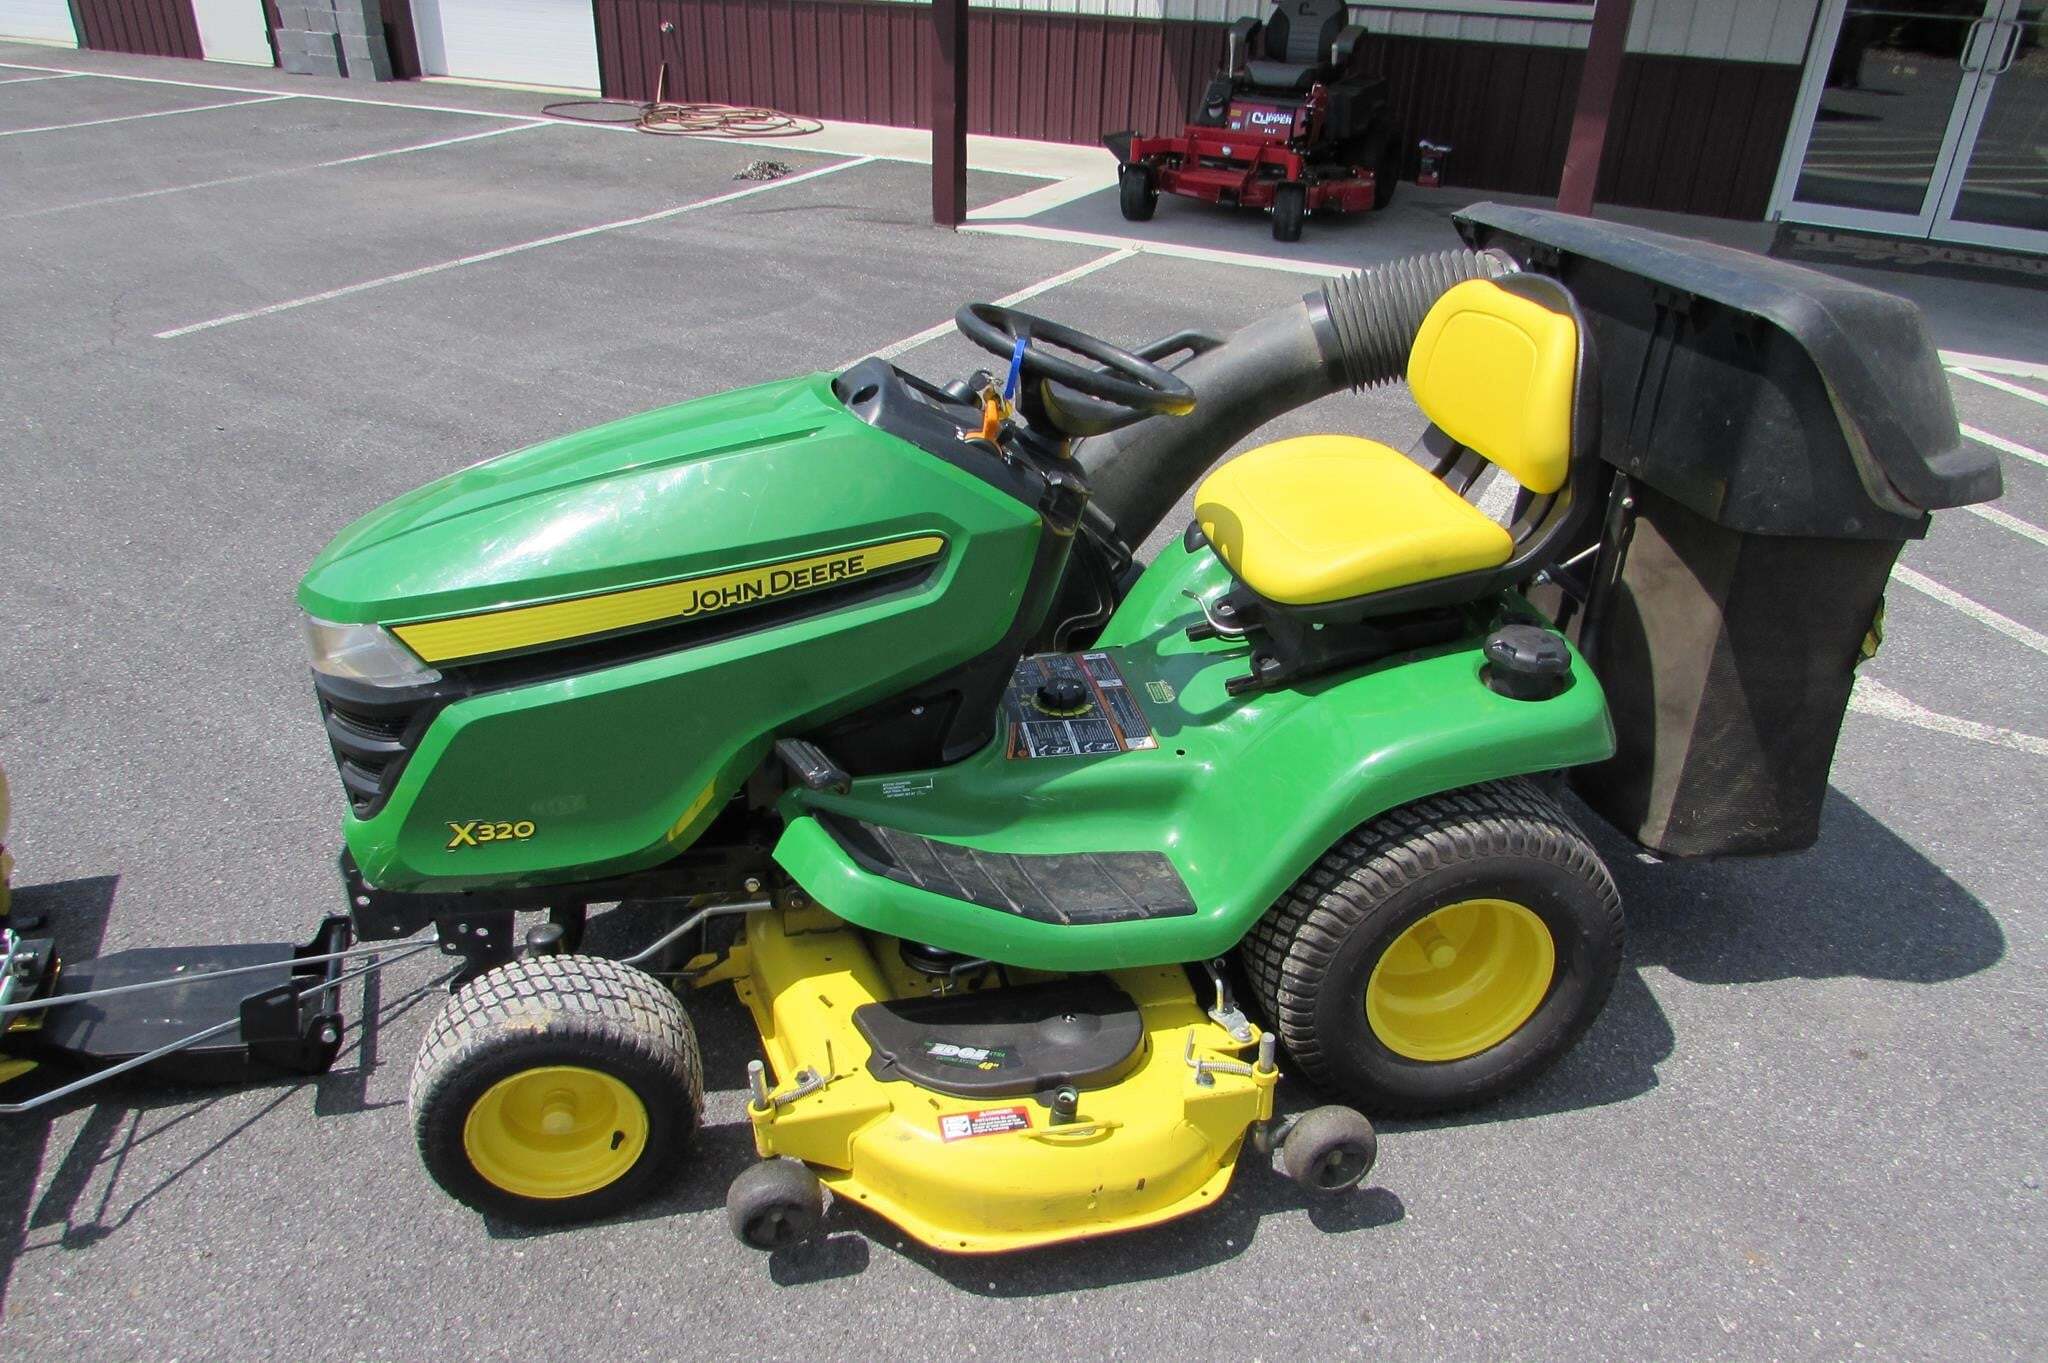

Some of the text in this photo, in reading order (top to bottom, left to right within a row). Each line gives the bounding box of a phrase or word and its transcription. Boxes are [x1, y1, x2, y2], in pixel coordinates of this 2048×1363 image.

[1251, 111, 1292, 125] CLIPPER
[683, 554, 865, 615] JOHN DEERE
[446, 820, 536, 848] X320
[927, 1042, 990, 1061] EDGE
